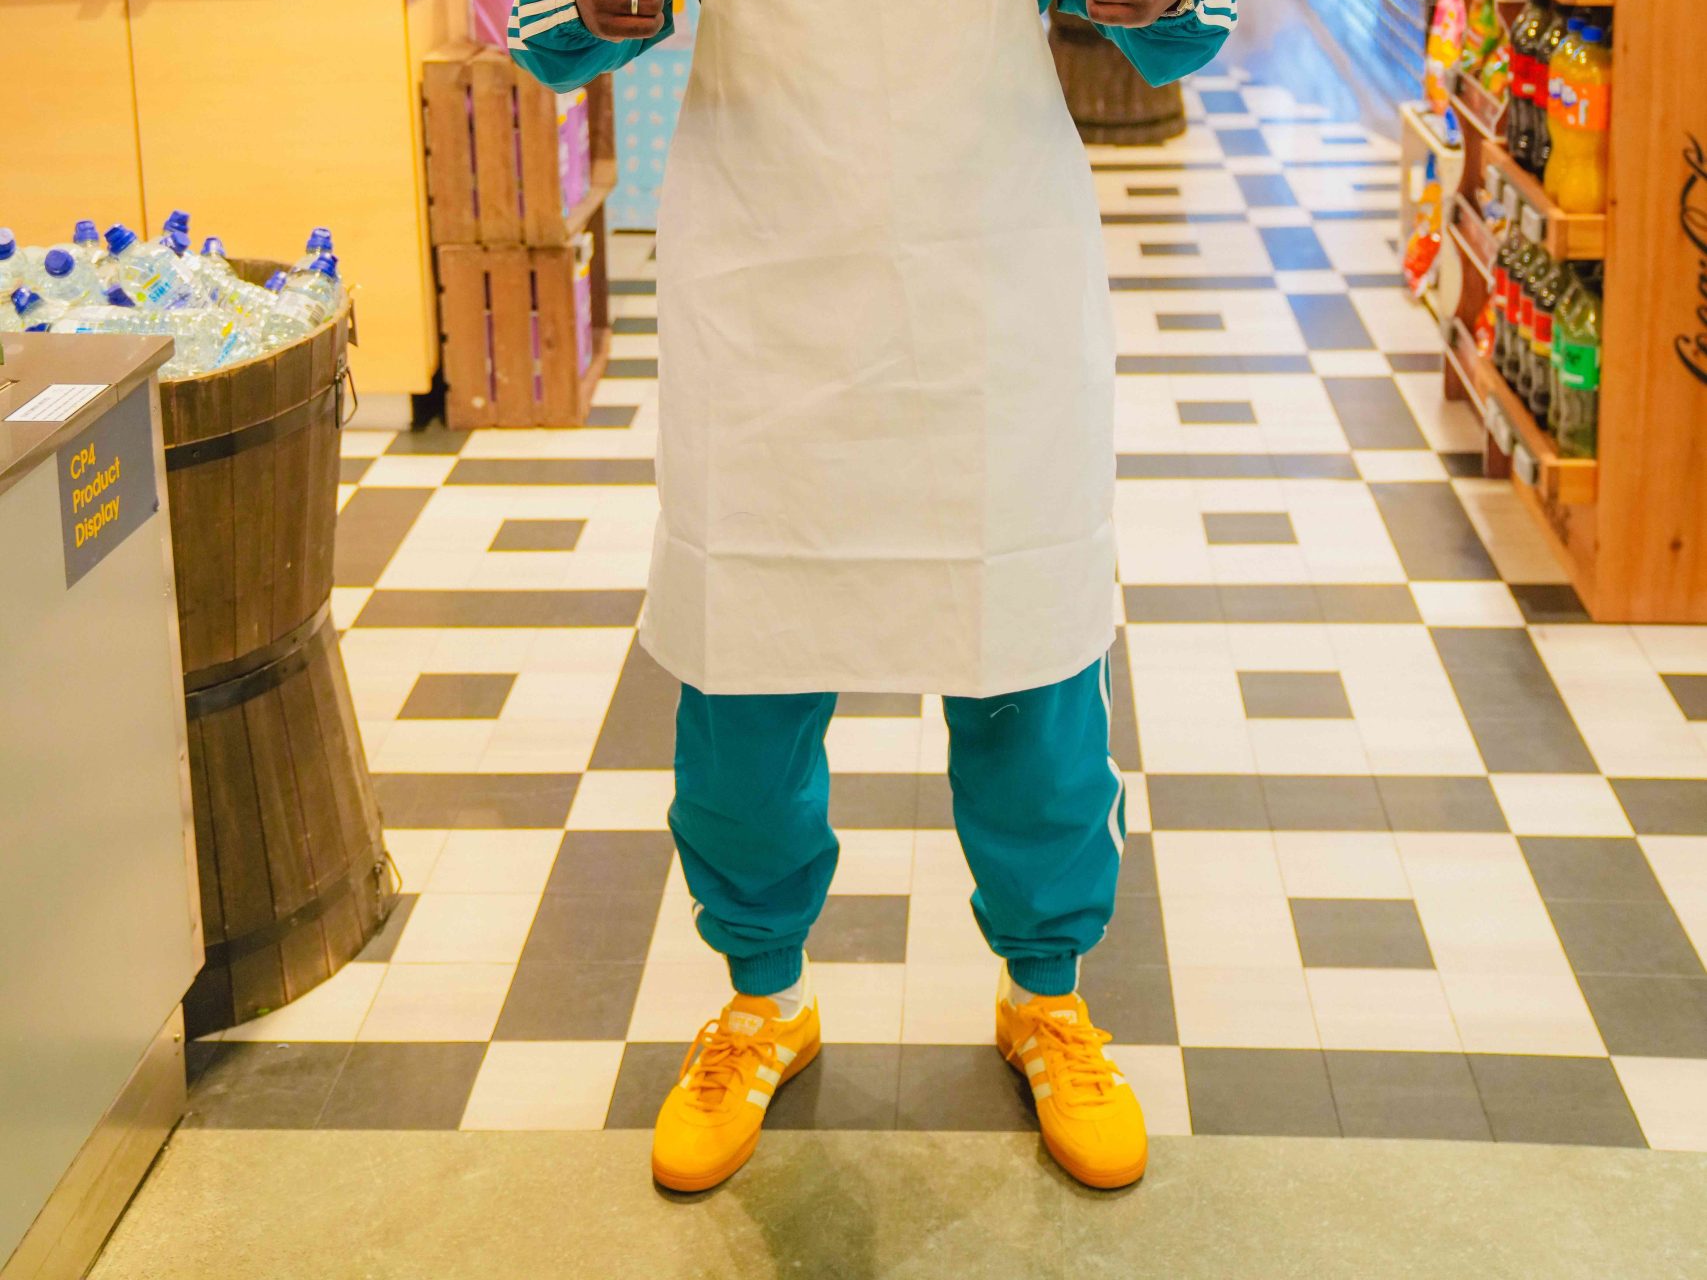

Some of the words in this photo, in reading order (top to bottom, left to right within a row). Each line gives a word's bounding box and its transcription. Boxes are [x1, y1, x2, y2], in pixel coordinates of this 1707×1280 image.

[70, 442, 96, 480] CP4
[72, 456, 121, 513] Product
[74, 495, 120, 548] Display
